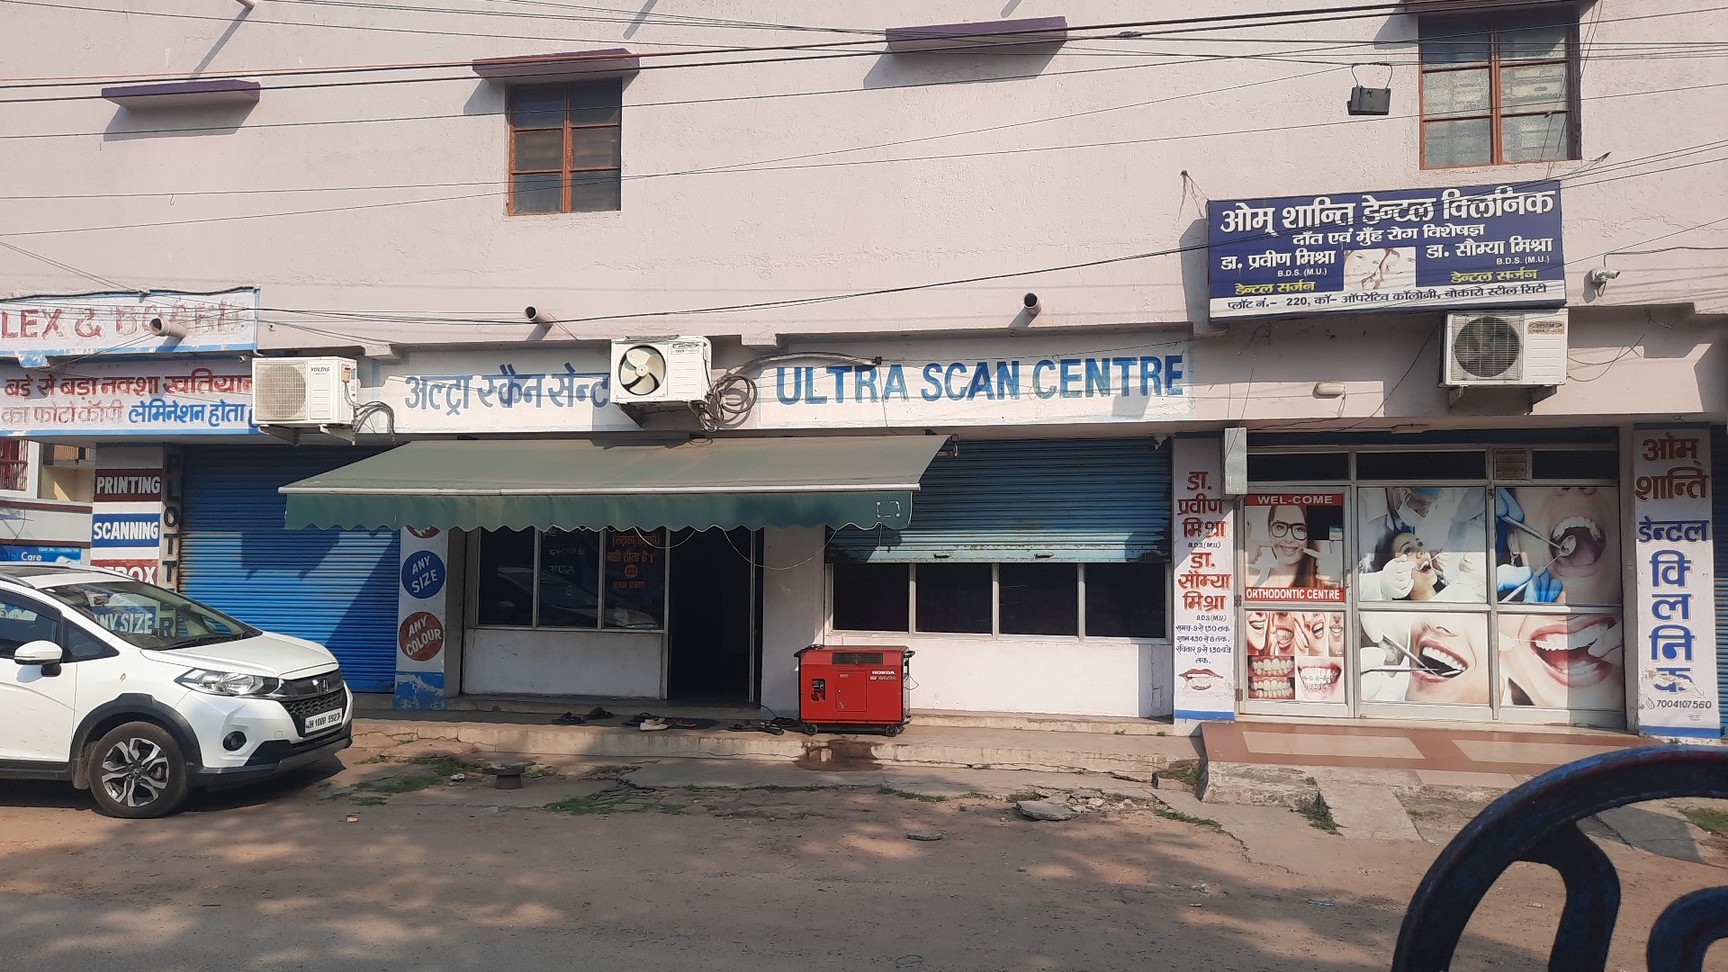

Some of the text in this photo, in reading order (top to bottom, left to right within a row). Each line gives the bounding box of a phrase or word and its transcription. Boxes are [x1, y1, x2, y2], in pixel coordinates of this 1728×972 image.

[1220, 185, 1555, 237] ओम् शान्ति डेन्टल क्लिनिक
[1328, 228, 1354, 245] एवं
[1356, 227, 1384, 247] मुँह
[1387, 226, 1418, 241] रोग
[1423, 223, 1485, 239] विशेषज्ञ
[1426, 235, 1553, 259] डा. सौम्या मिश्रा
[1221, 248, 1336, 271] डा. प्रवीण मिश्रा
[1496, 256, 1550, 265] B.D.S. (M.U.)
[1304, 268, 1328, 277] (M.U.)
[1451, 267, 1538, 284] डेन्टल सर्जन
[1235, 279, 1316, 295] डेन्टल सर्जन
[1286, 297, 1311, 307] 220,
[1445, 286, 1484, 299] बोकारो
[1487, 284, 1518, 297] स्टील
[1520, 282, 1547, 295] सिटी
[38, 374, 58, 397] से
[60, 376, 99, 401] बड़ा
[101, 375, 160, 397] नक्शा
[404, 374, 473, 417] अल्ट्रा
[477, 363, 546, 409] स्कैन
[776, 355, 1184, 406] ULTRA SCAN CENTRE
[128, 399, 206, 425] लेमिनेशन
[208, 400, 246, 427] होता
[1642, 432, 1702, 465] ओम्
[96, 475, 161, 495] PRINTING
[1186, 471, 1212, 491] डा.
[1634, 466, 1709, 501] शान्ति
[1177, 493, 1225, 516] प्रवीण
[1257, 495, 1333, 505] WEL-COME
[93, 521, 159, 540] SCANNING
[1182, 517, 1226, 539] मिश्रा
[1638, 515, 1710, 542] डेन्टल
[20, 551, 43, 562] Care
[412, 556, 431, 575] ANY
[1190, 552, 1216, 569] डा.
[411, 569, 438, 593] SIZE
[1178, 570, 1232, 590] सौम्या
[1182, 590, 1226, 612] मिश्रा
[1246, 588, 1340, 600] ORTHODONTIC CENTRE
[94, 612, 153, 635] NY SIZE
[408, 615, 428, 638] ANY
[406, 628, 442, 656] COLOUR
[1656, 699, 1712, 710] 7004107560
